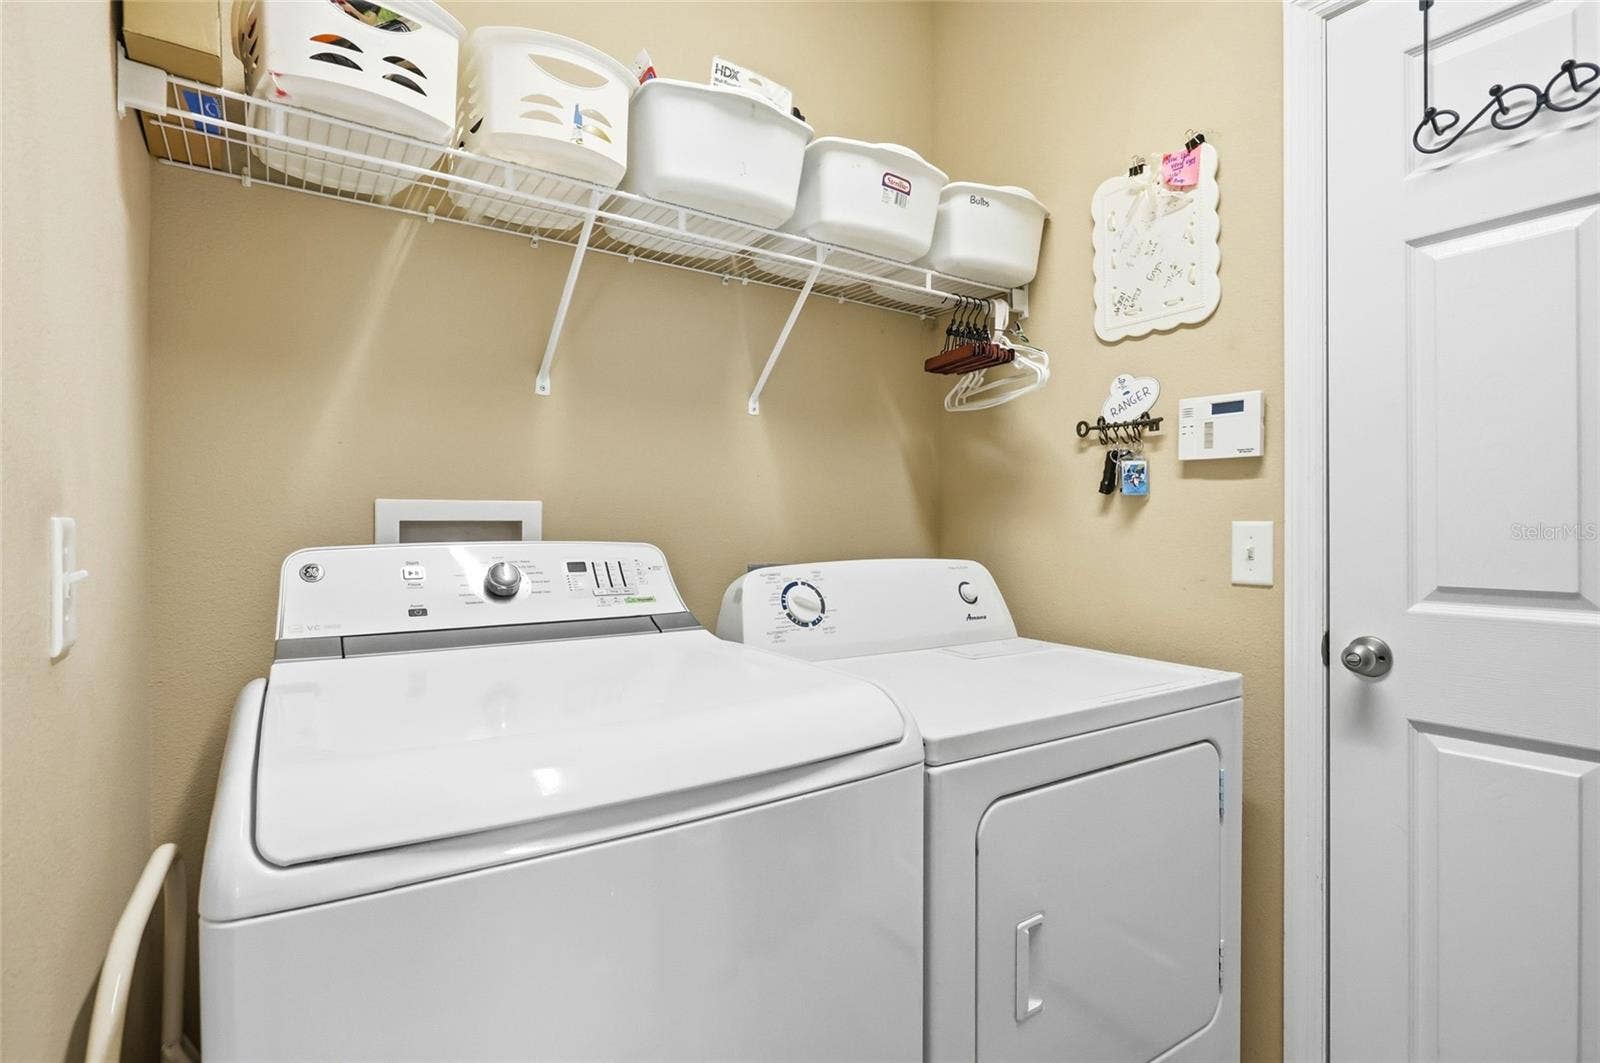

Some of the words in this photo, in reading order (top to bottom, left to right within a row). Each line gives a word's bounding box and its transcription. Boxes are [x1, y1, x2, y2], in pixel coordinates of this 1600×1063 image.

[714, 62, 740, 82] HDX
[969, 194, 991, 208] Bulbs
[1109, 385, 1152, 418] RANGER
